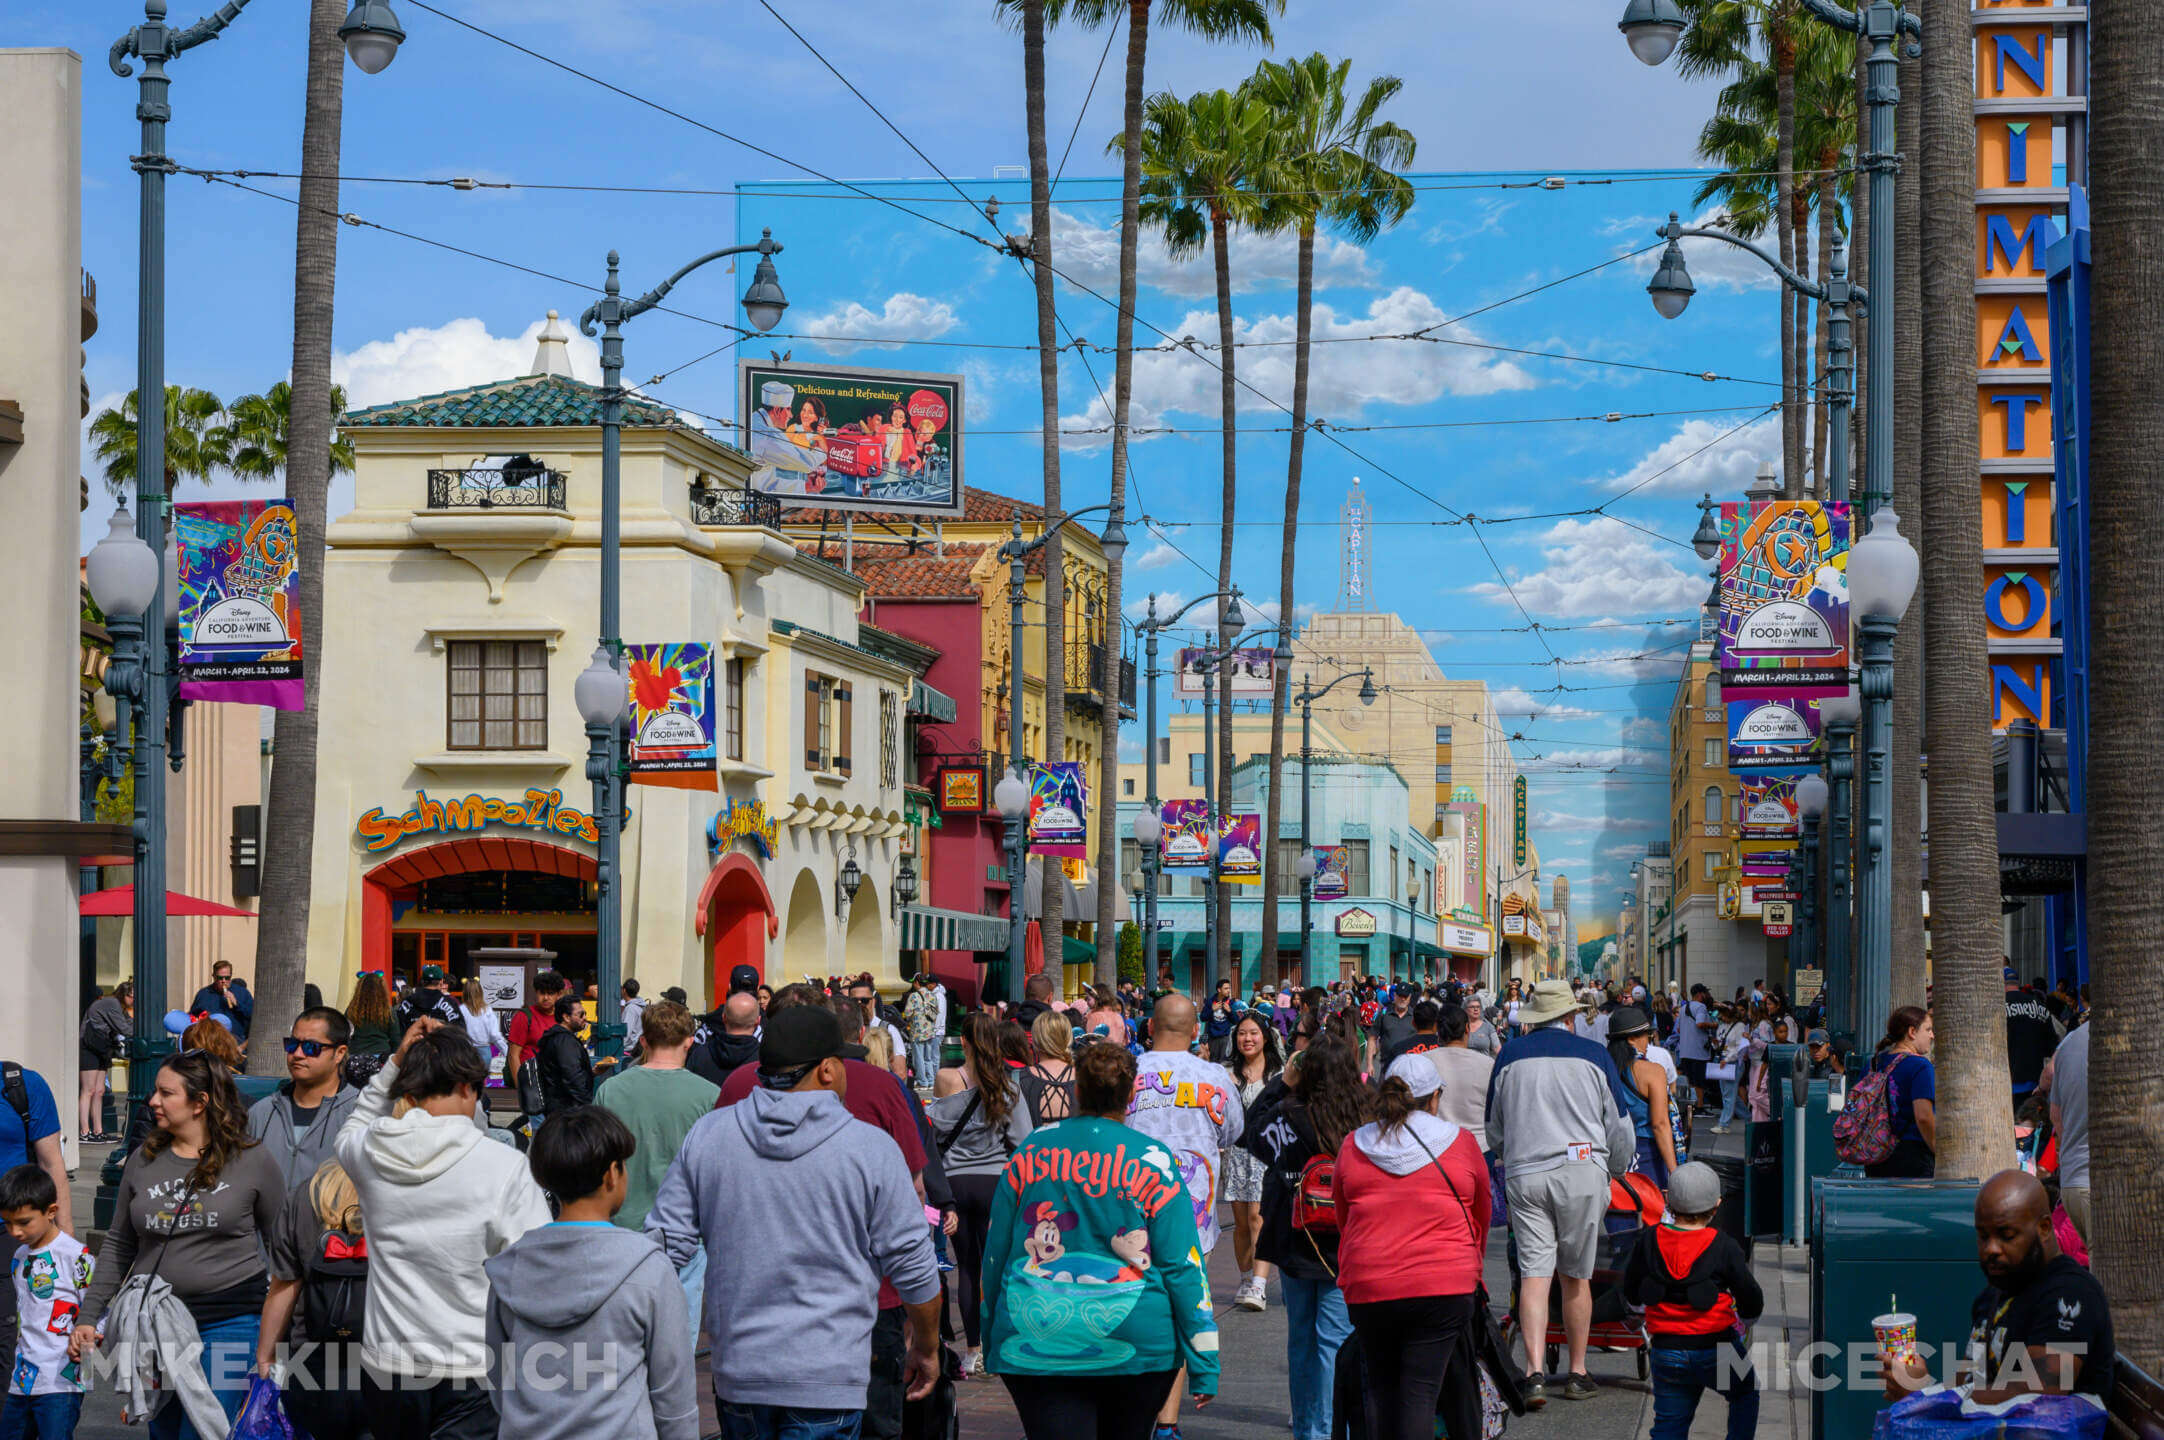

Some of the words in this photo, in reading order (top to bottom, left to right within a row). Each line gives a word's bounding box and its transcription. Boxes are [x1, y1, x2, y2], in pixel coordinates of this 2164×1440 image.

[1984, 0, 2049, 722] NIMATION
[839, 388, 854, 398] and
[909, 404, 945, 419] Coca-Cola
[208, 623, 238, 634] FOOD
[244, 622, 272, 633] WINE
[1750, 627, 1782, 639] FOOD
[1789, 627, 1819, 638] WINE
[193, 667, 223, 676] MARCH
[270, 666, 290, 674] 2024
[1734, 673, 1765, 683] MARCH
[1814, 673, 1835, 681] 2024
[650, 730, 672, 739] FOOD
[676, 729, 696, 738] WINE
[1748, 724, 1772, 733] FOOD
[1777, 724, 1798, 732] WINE
[1517, 791, 1526, 857] CAPITAN
[1174, 1081, 1230, 1126] ART
[1003, 1143, 1181, 1219] Disneyland
[147, 1178, 231, 1200] MICY
